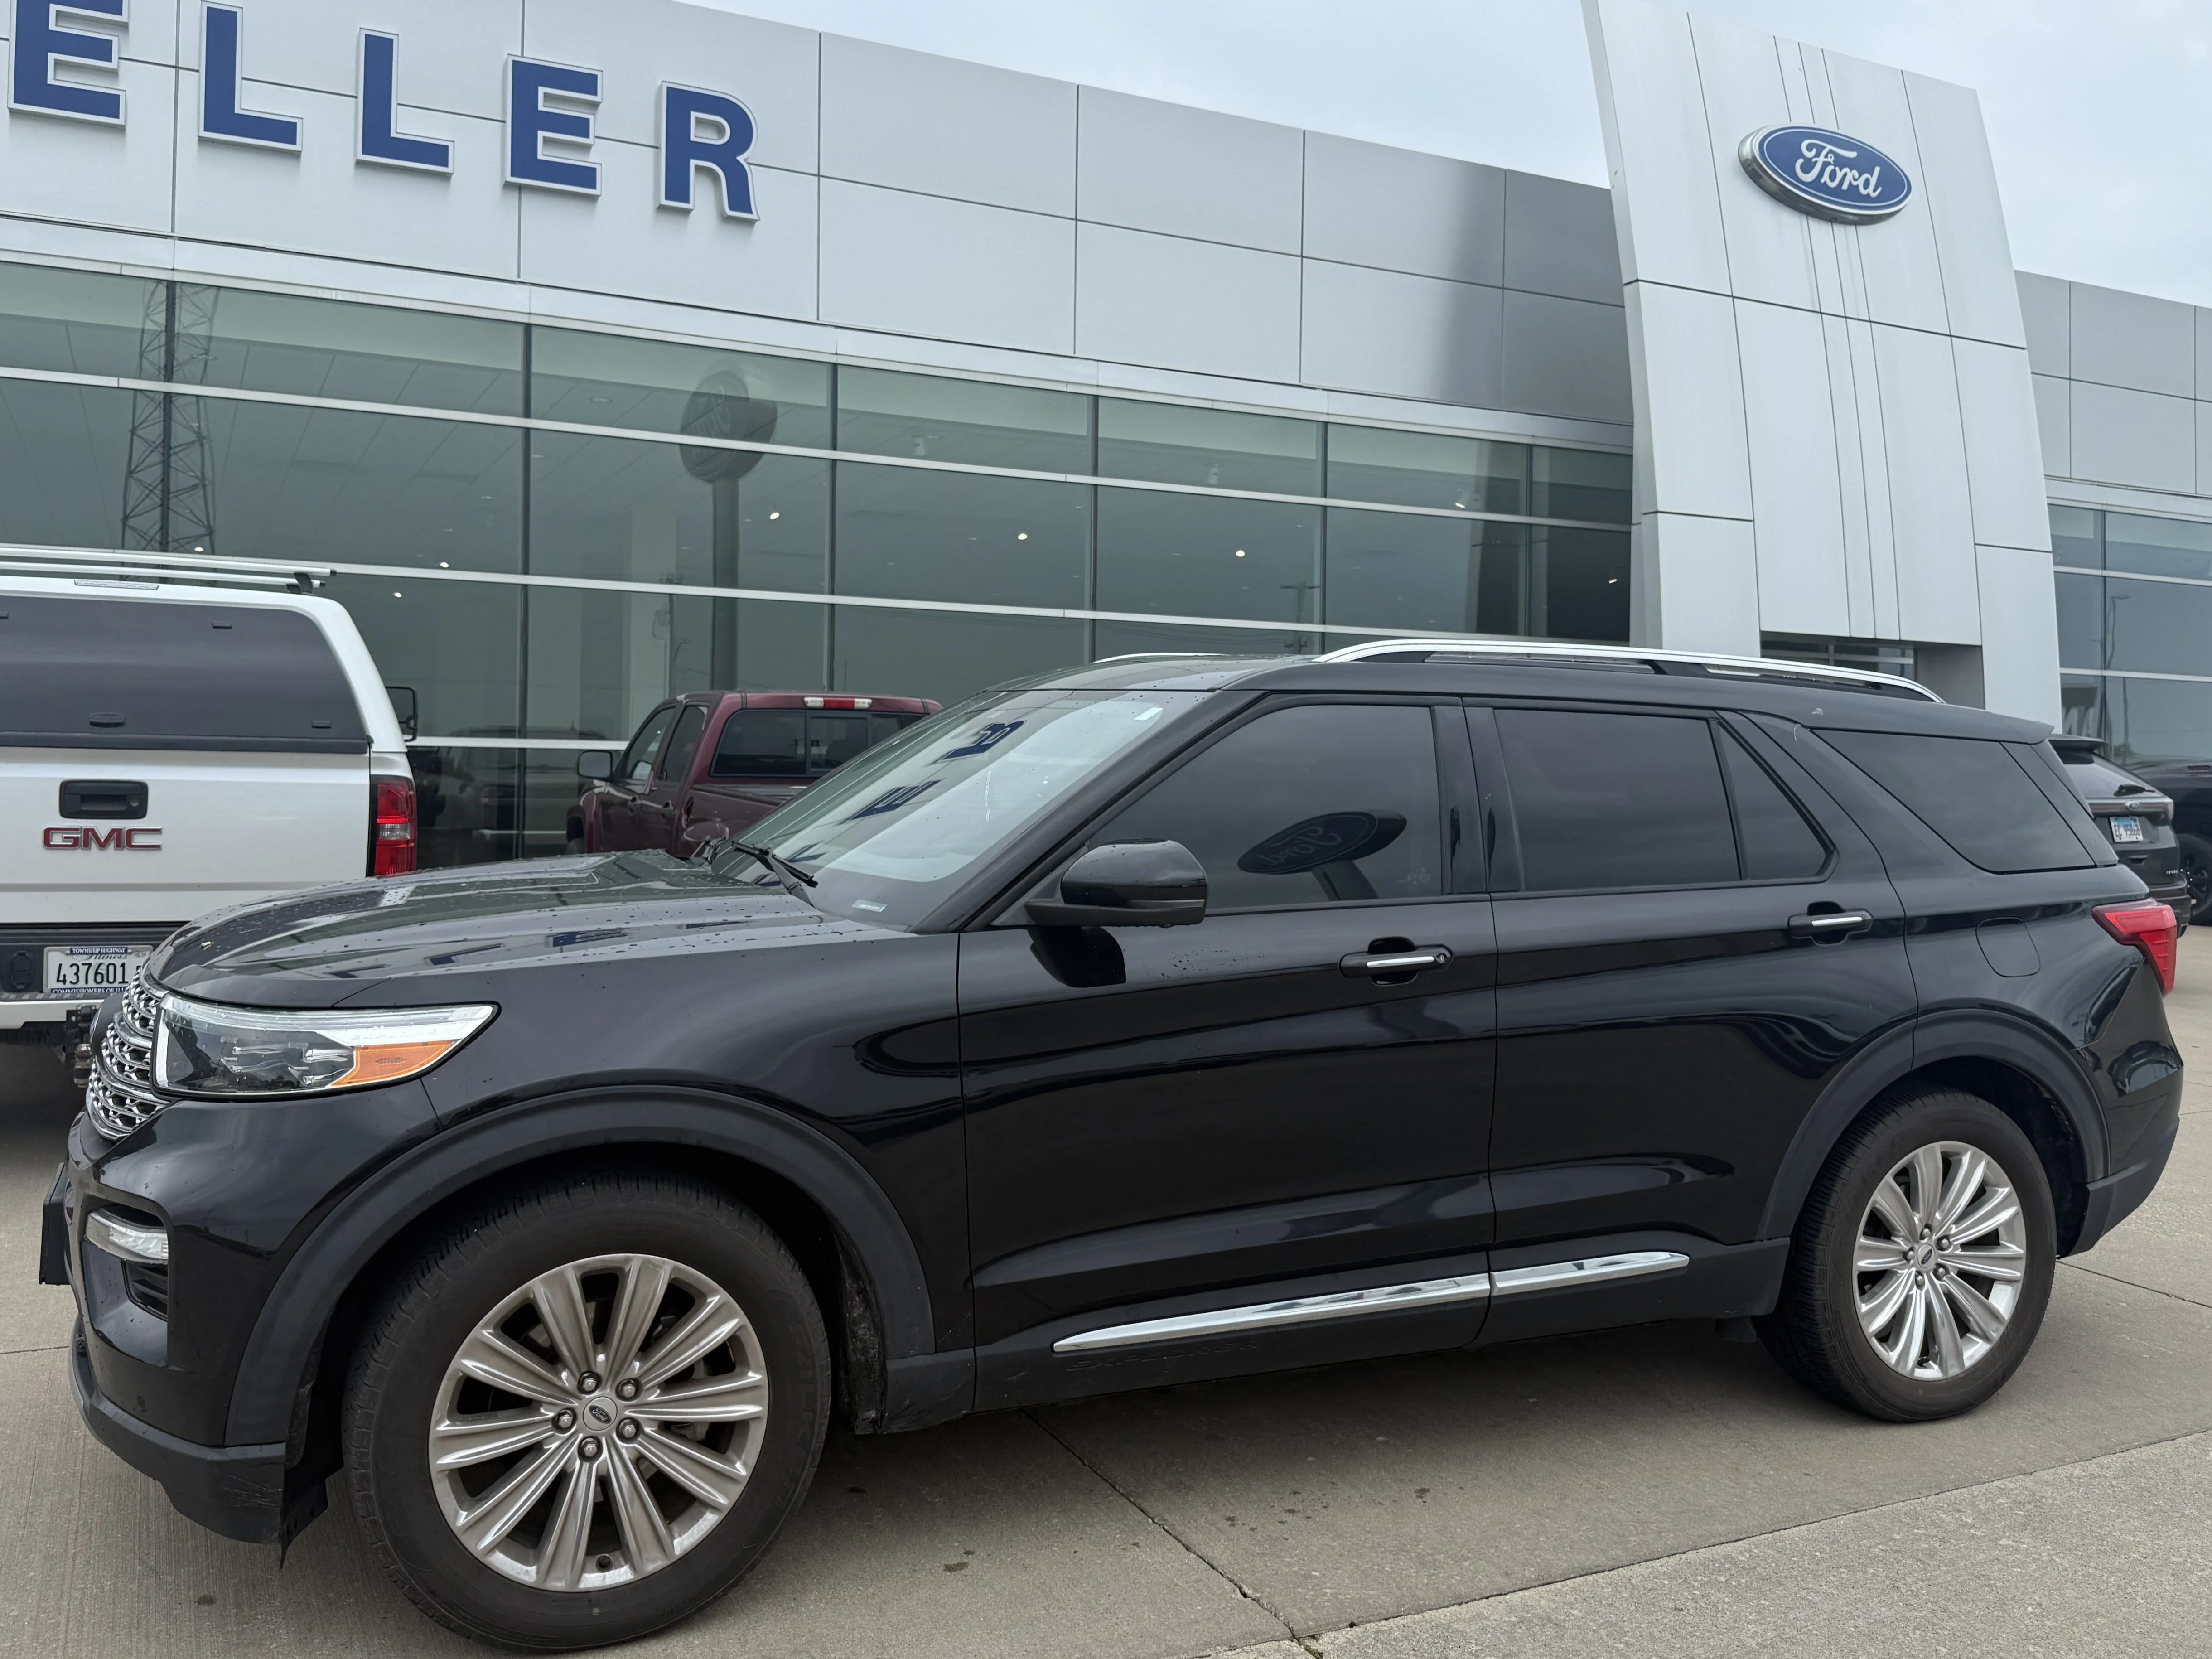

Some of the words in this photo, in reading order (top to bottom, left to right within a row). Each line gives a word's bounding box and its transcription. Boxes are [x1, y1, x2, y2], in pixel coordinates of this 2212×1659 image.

[8, 0, 760, 222] ELLER
[1795, 139, 1882, 198] Ford
[43, 826, 163, 850] GMC
[56, 962, 129, 985] 437601
[592, 1408, 608, 1421] Ford
